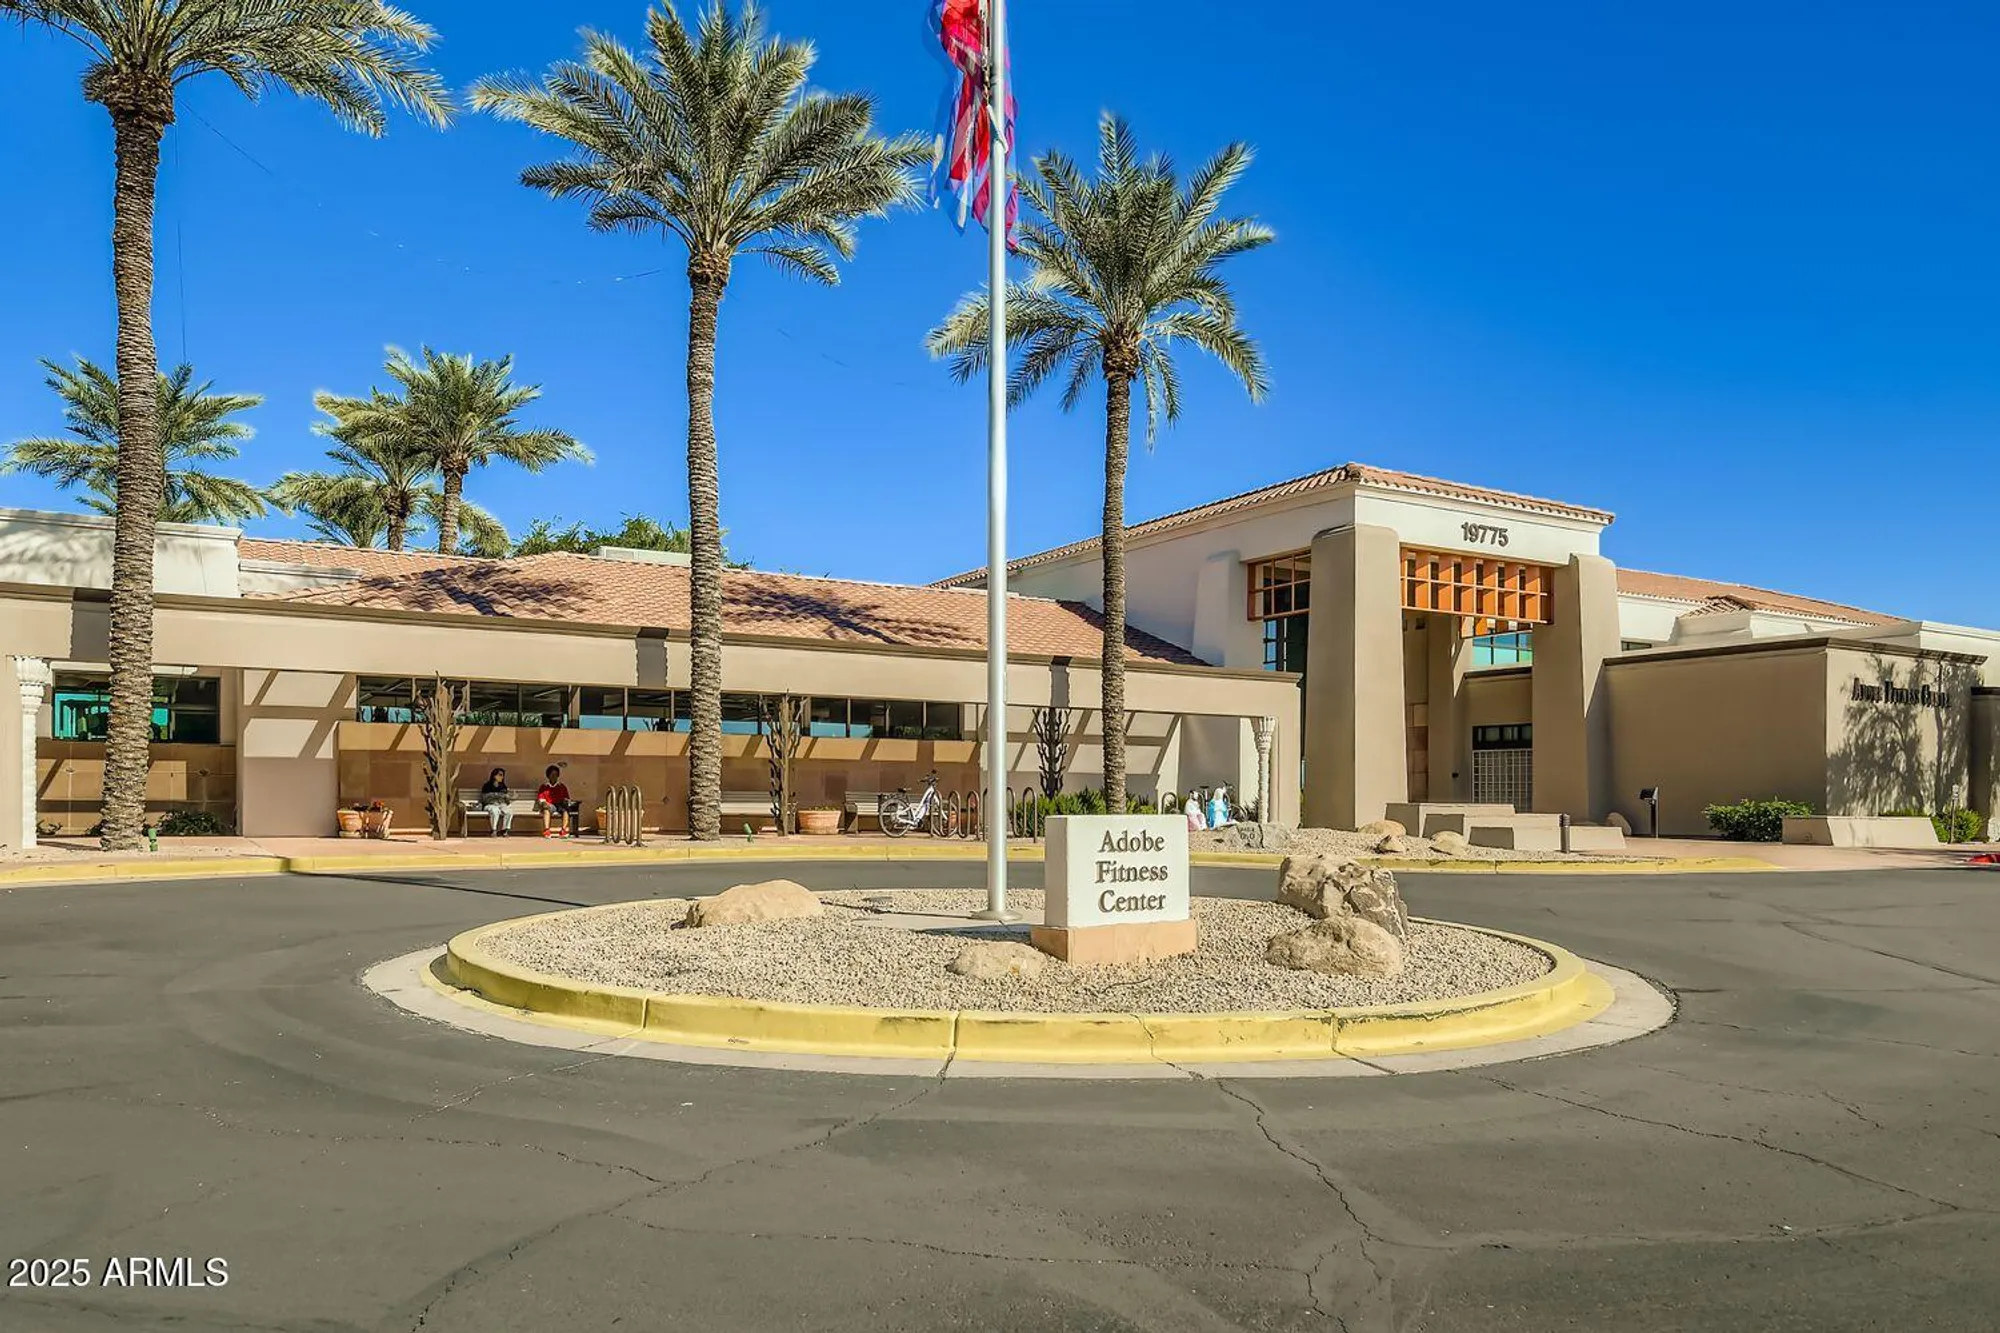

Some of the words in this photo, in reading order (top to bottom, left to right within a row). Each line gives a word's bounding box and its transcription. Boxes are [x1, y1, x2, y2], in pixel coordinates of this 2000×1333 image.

[1461, 521, 1509, 548] 19775
[1098, 829, 1165, 853] Adobe
[1095, 860, 1168, 884] Fitness
[1098, 889, 1166, 913] Center
